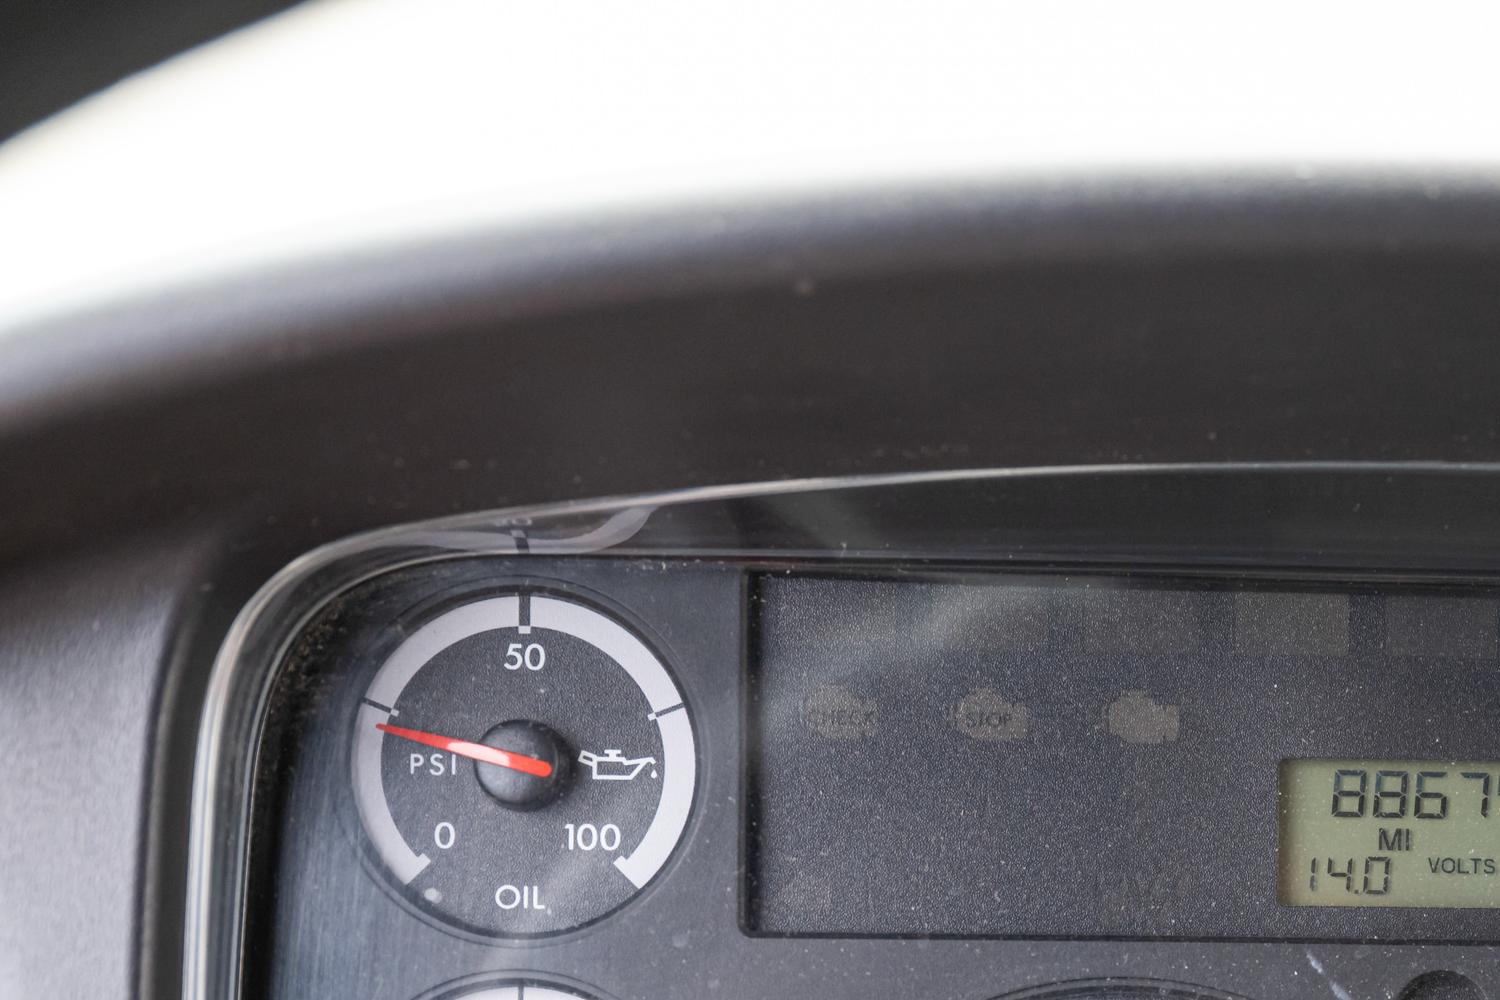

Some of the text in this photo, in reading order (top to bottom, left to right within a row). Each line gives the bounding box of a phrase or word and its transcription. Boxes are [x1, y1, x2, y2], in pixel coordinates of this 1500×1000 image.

[503, 643, 546, 671] 50
[409, 753, 457, 777] PSI
[434, 821, 456, 850] 0
[564, 823, 622, 852] 100
[1378, 828, 1411, 851] MI
[1309, 856, 1496, 895] 14.0 VOLTS
[494, 884, 546, 910] OIL
